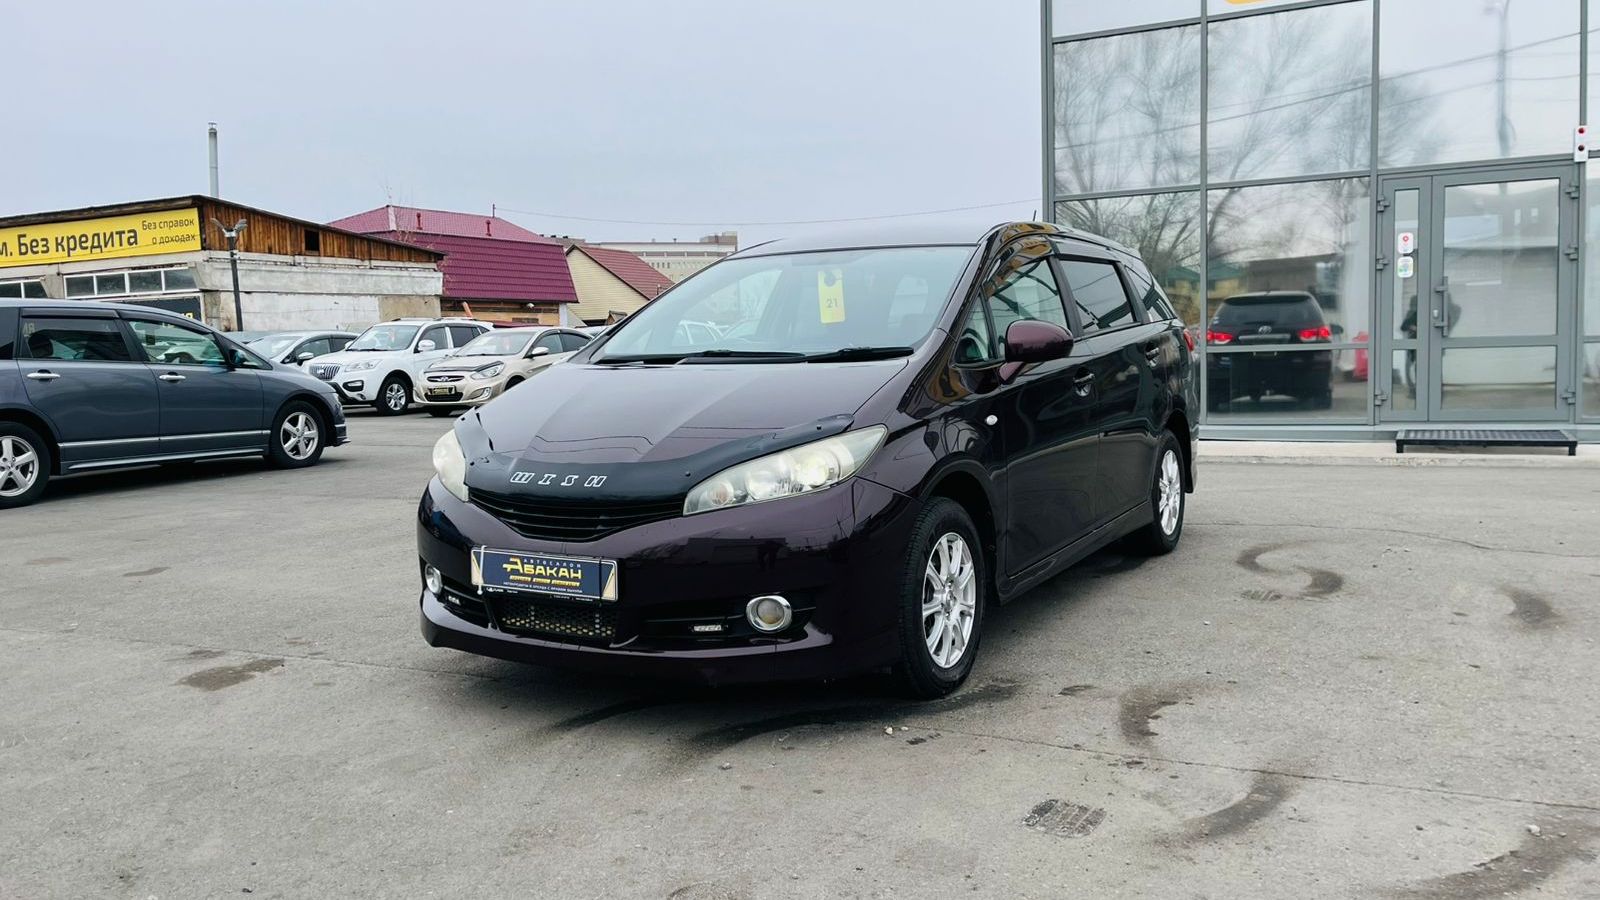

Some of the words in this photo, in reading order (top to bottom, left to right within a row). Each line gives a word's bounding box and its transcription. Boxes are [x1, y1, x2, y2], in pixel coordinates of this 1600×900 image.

[141, 220, 157, 231] Без
[158, 218, 195, 232] справок
[17, 233, 50, 256] Без
[55, 228, 138, 258] кредита
[151, 236, 157, 245] о
[159, 232, 196, 244] доходах
[825, 297, 838, 309] 21
[510, 471, 608, 488] WISH
[523, 558, 582, 568] АВТОСАЛОН
